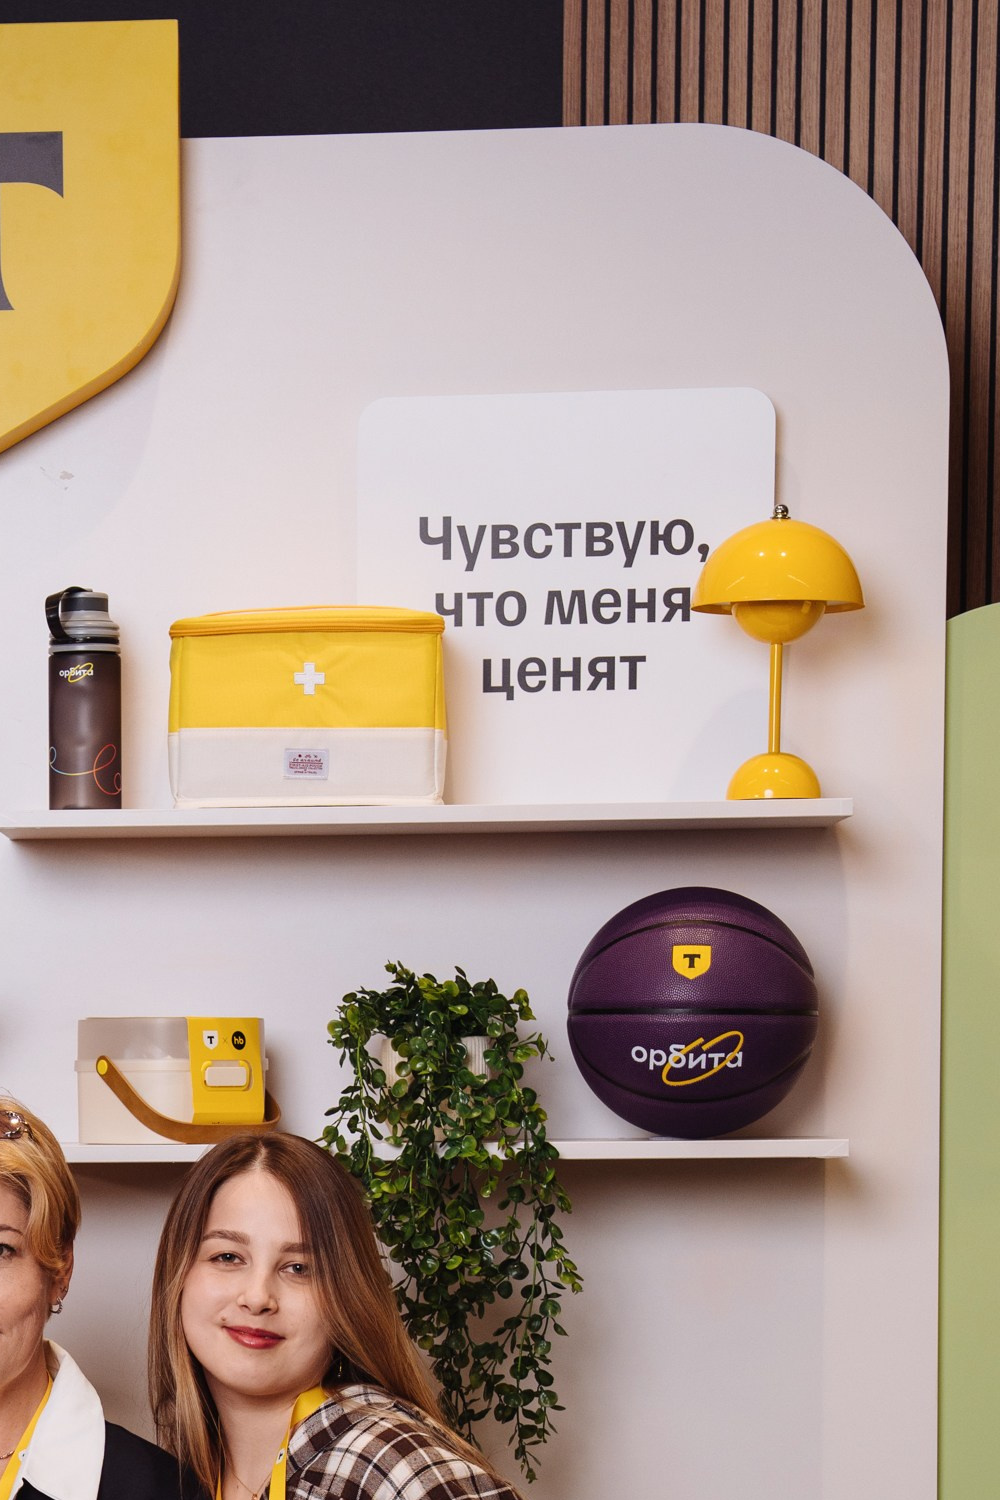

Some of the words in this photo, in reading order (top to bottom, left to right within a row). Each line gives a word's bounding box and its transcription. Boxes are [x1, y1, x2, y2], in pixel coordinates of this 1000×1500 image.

[419, 516, 710, 572] Чувствую,
[435, 590, 527, 627] что
[544, 586, 692, 625] меня
[482, 655, 647, 701] ценят
[683, 953, 701, 968] Т
[631, 1043, 743, 1071] орбита
